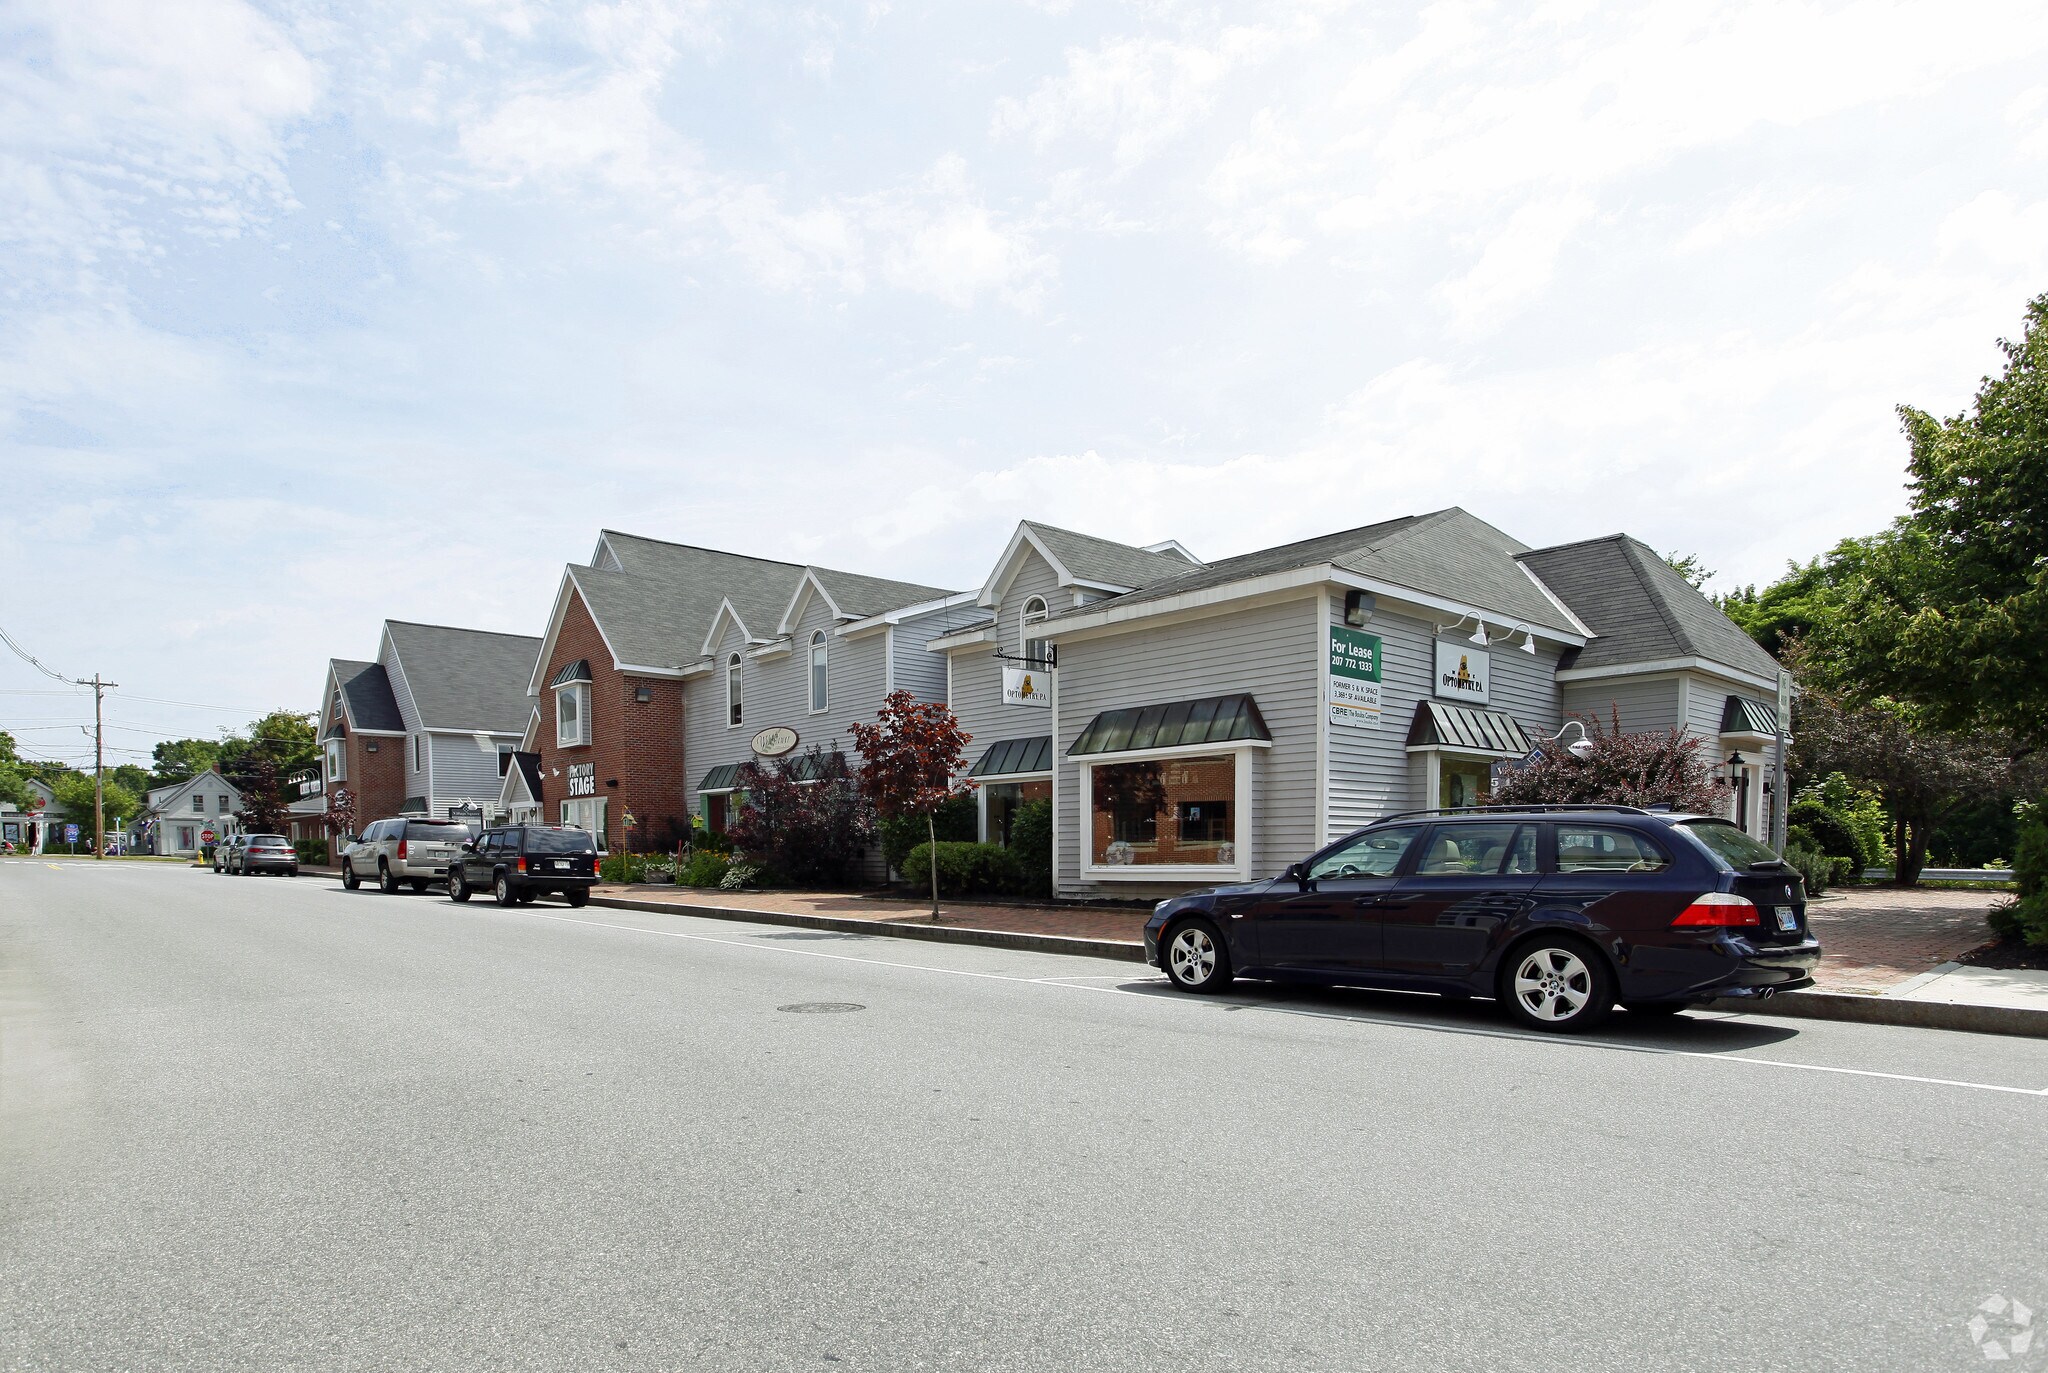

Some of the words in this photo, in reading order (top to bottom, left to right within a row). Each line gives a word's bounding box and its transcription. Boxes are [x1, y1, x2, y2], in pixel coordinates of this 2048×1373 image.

[1331, 638, 1346, 654] For
[1348, 642, 1372, 660] Lease
[1331, 655, 1343, 666] 207
[1345, 658, 1356, 669] 772
[1358, 660, 1373, 672] 1333
[1333, 680, 1351, 691] FORMER
[1365, 687, 1378, 696] SPACE
[1354, 695, 1377, 705] AVAILABLE
[1331, 706, 1348, 716] CBRE
[569, 775, 595, 797] STAGE
